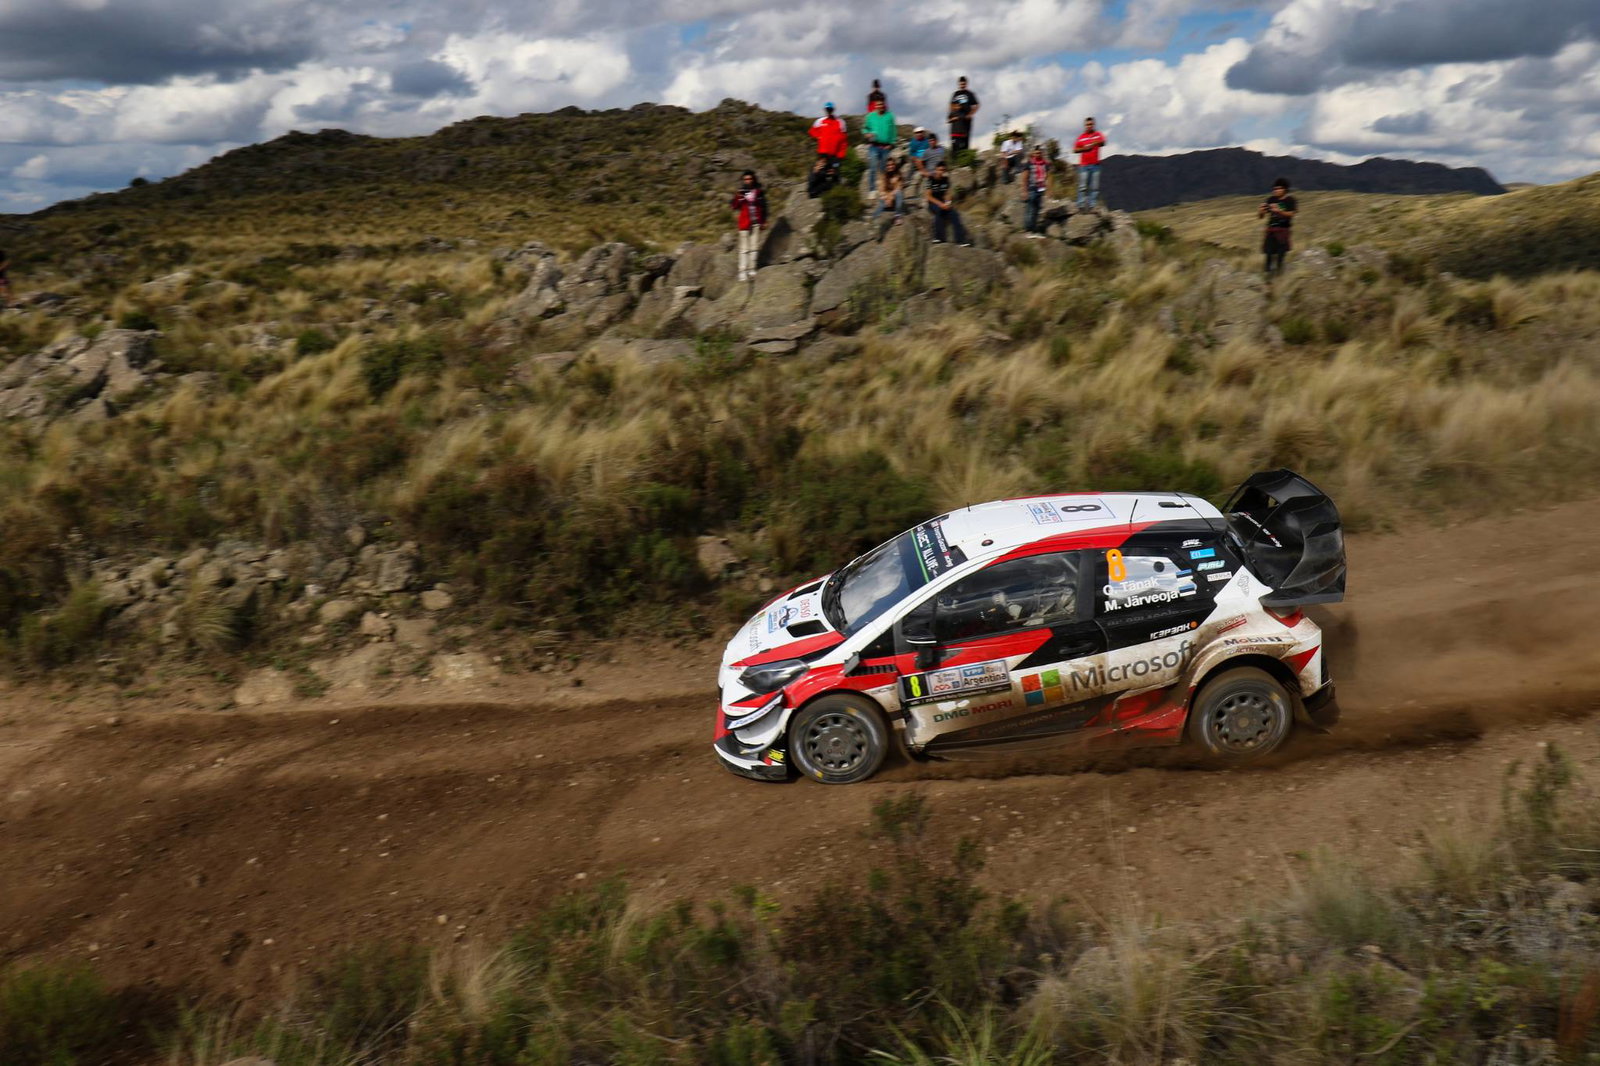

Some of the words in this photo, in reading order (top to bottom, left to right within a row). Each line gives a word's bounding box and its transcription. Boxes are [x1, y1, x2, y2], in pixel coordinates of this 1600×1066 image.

[1106, 548, 1127, 582] 8
[1120, 576, 1160, 592] Tänak
[1104, 599, 1121, 613] M.
[1124, 589, 1179, 609] Järveoja
[1224, 636, 1266, 646] Mobil
[1071, 640, 1197, 692] Microsoft
[910, 675, 922, 697] 8
[963, 672, 1007, 687] Argentina
[933, 708, 970, 723] DMG
[972, 700, 1012, 715] MORI
